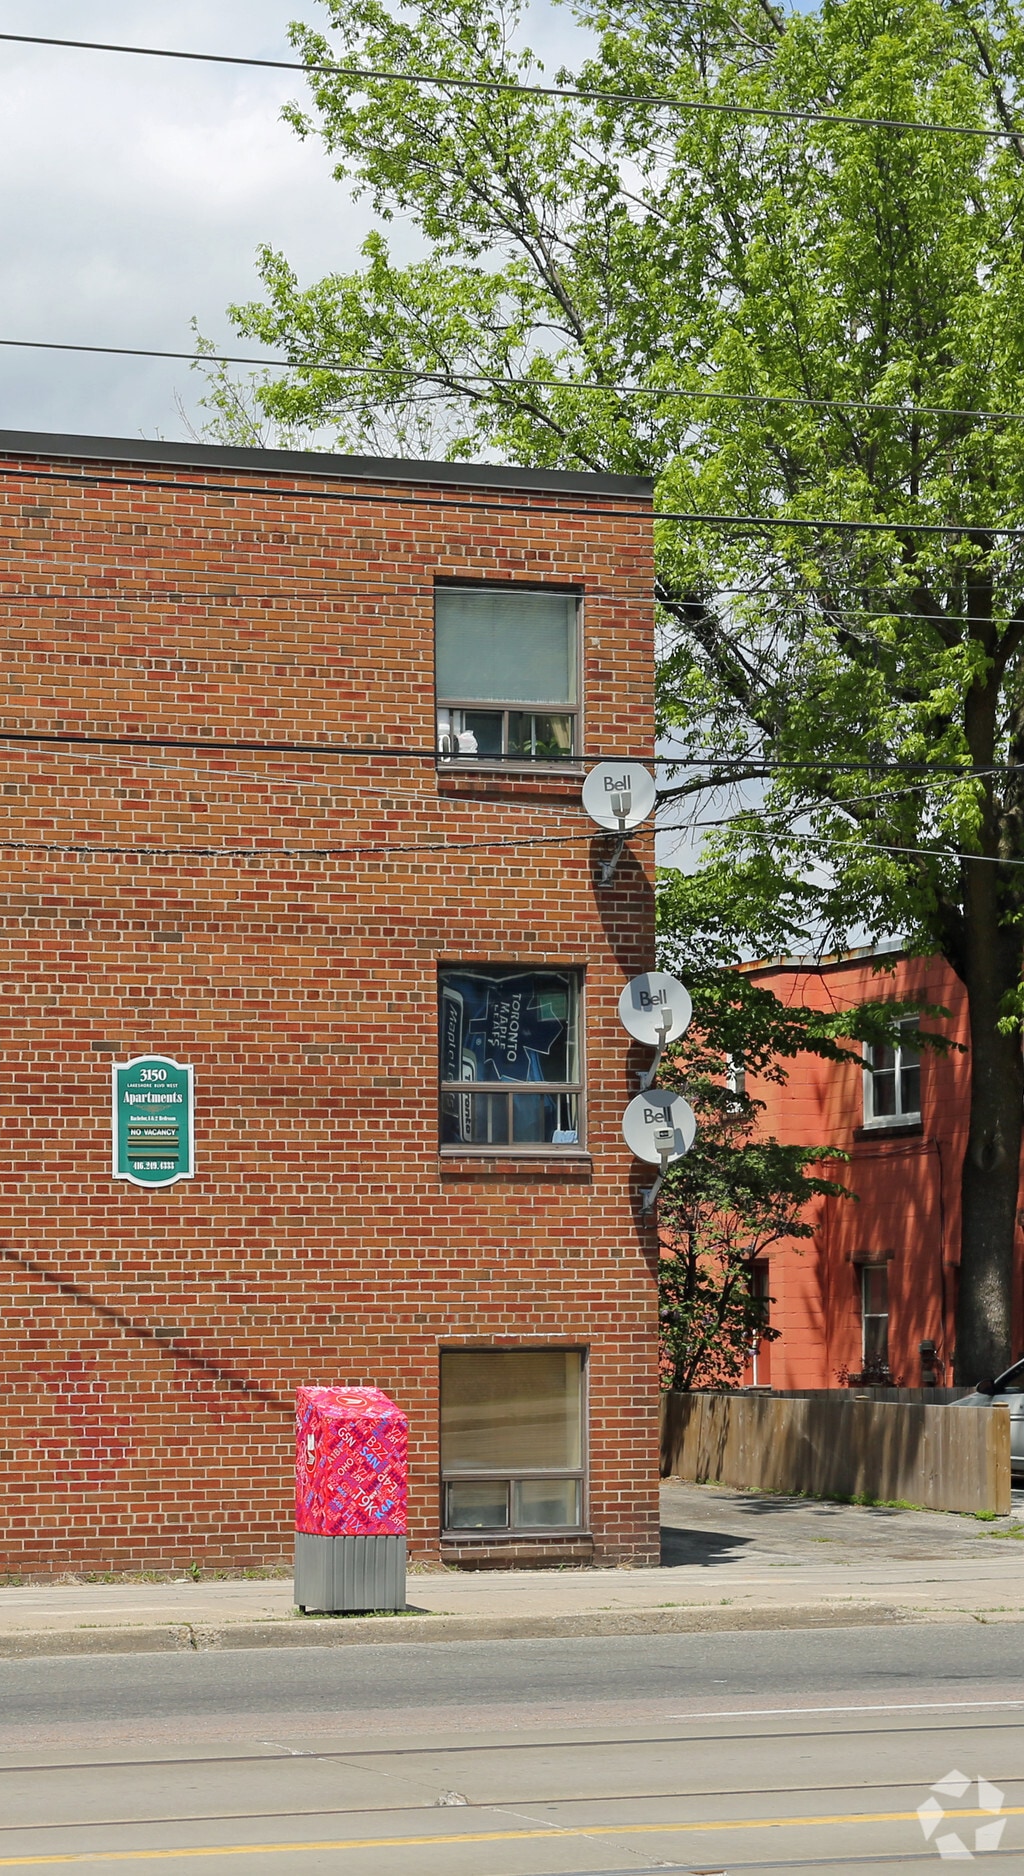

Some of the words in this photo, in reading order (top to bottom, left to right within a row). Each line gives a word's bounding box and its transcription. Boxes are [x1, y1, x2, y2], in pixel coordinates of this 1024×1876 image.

[603, 774, 631, 791] Bell
[639, 989, 667, 1006] Bell
[487, 1004, 500, 1046] LEAFS
[499, 1001, 511, 1050] MAPLE
[507, 993, 522, 1062] TORONTO
[139, 1068, 167, 1082] 3150
[123, 1091, 183, 1105] Apartments
[643, 1106, 671, 1124] Bell
[130, 1128, 142, 1136] NO
[143, 1128, 176, 1136] VACANCY
